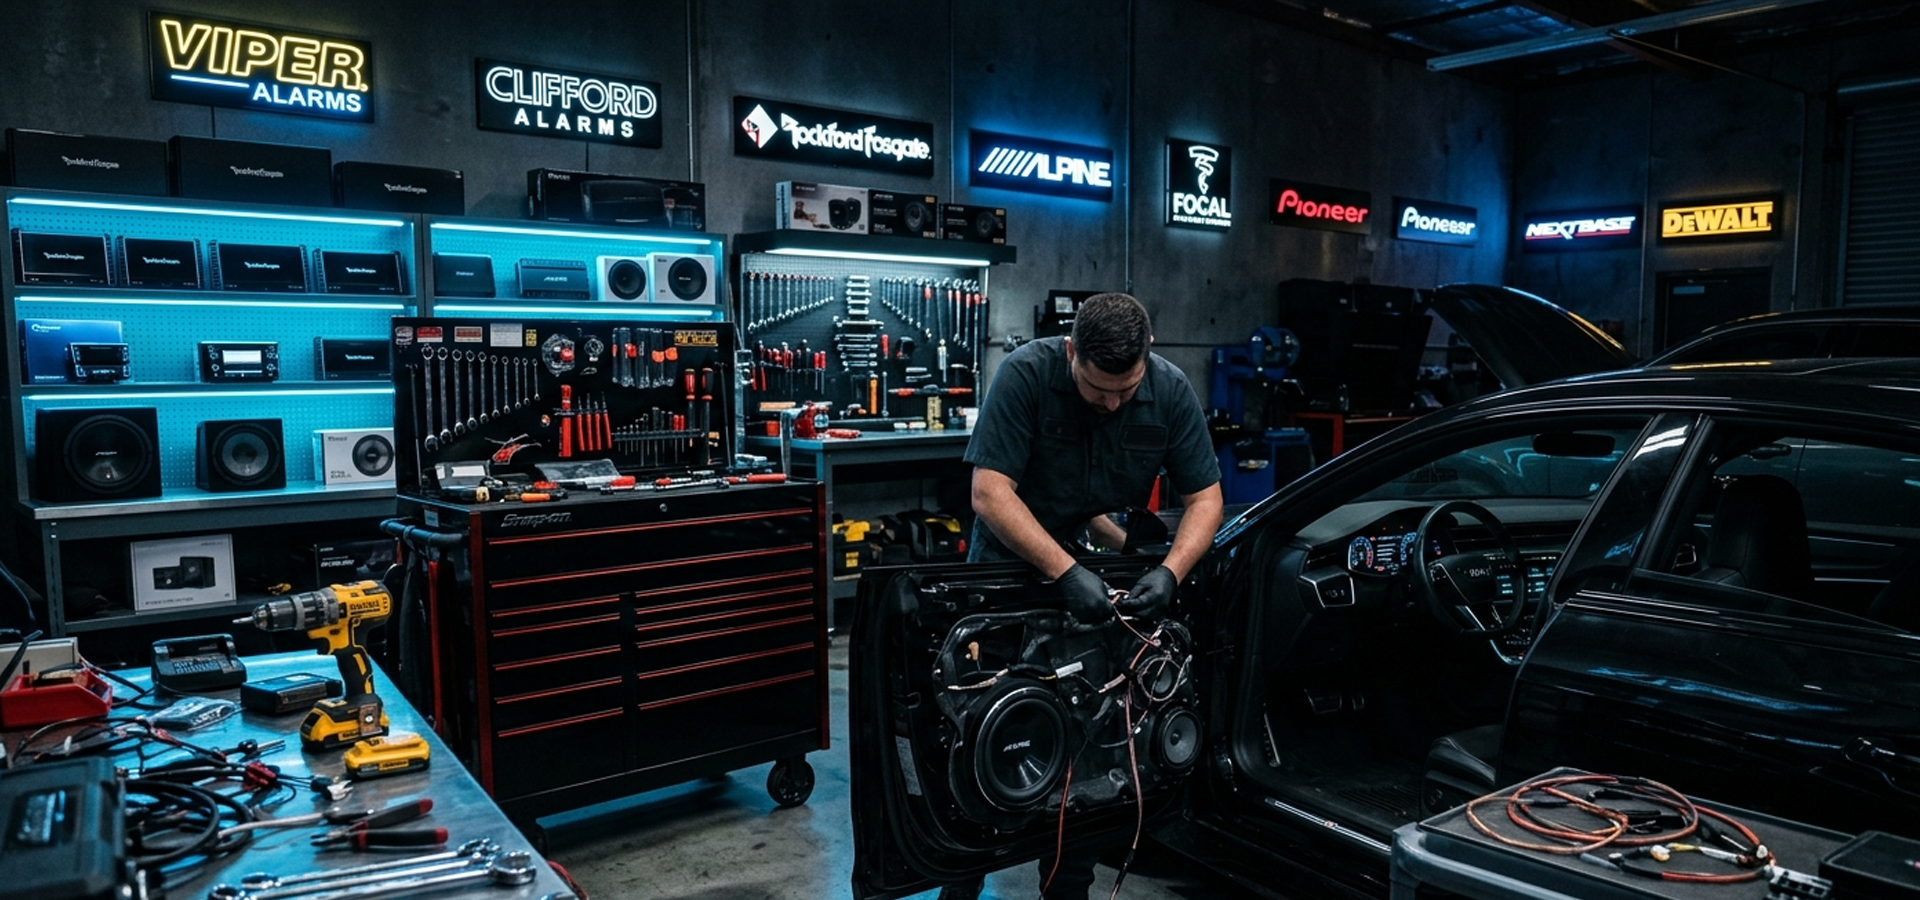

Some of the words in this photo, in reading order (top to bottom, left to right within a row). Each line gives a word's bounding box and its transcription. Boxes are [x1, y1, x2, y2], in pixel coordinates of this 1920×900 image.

[253, 83, 361, 112] ALARMS
[486, 66, 657, 119] CLIFFORD
[514, 108, 634, 138] ALARMS
[1021, 153, 1111, 188] ALPINE
[1173, 192, 1231, 218] FOCAL
[1277, 189, 1368, 223] Pioneer
[1525, 216, 1636, 240] NEXTBASE
